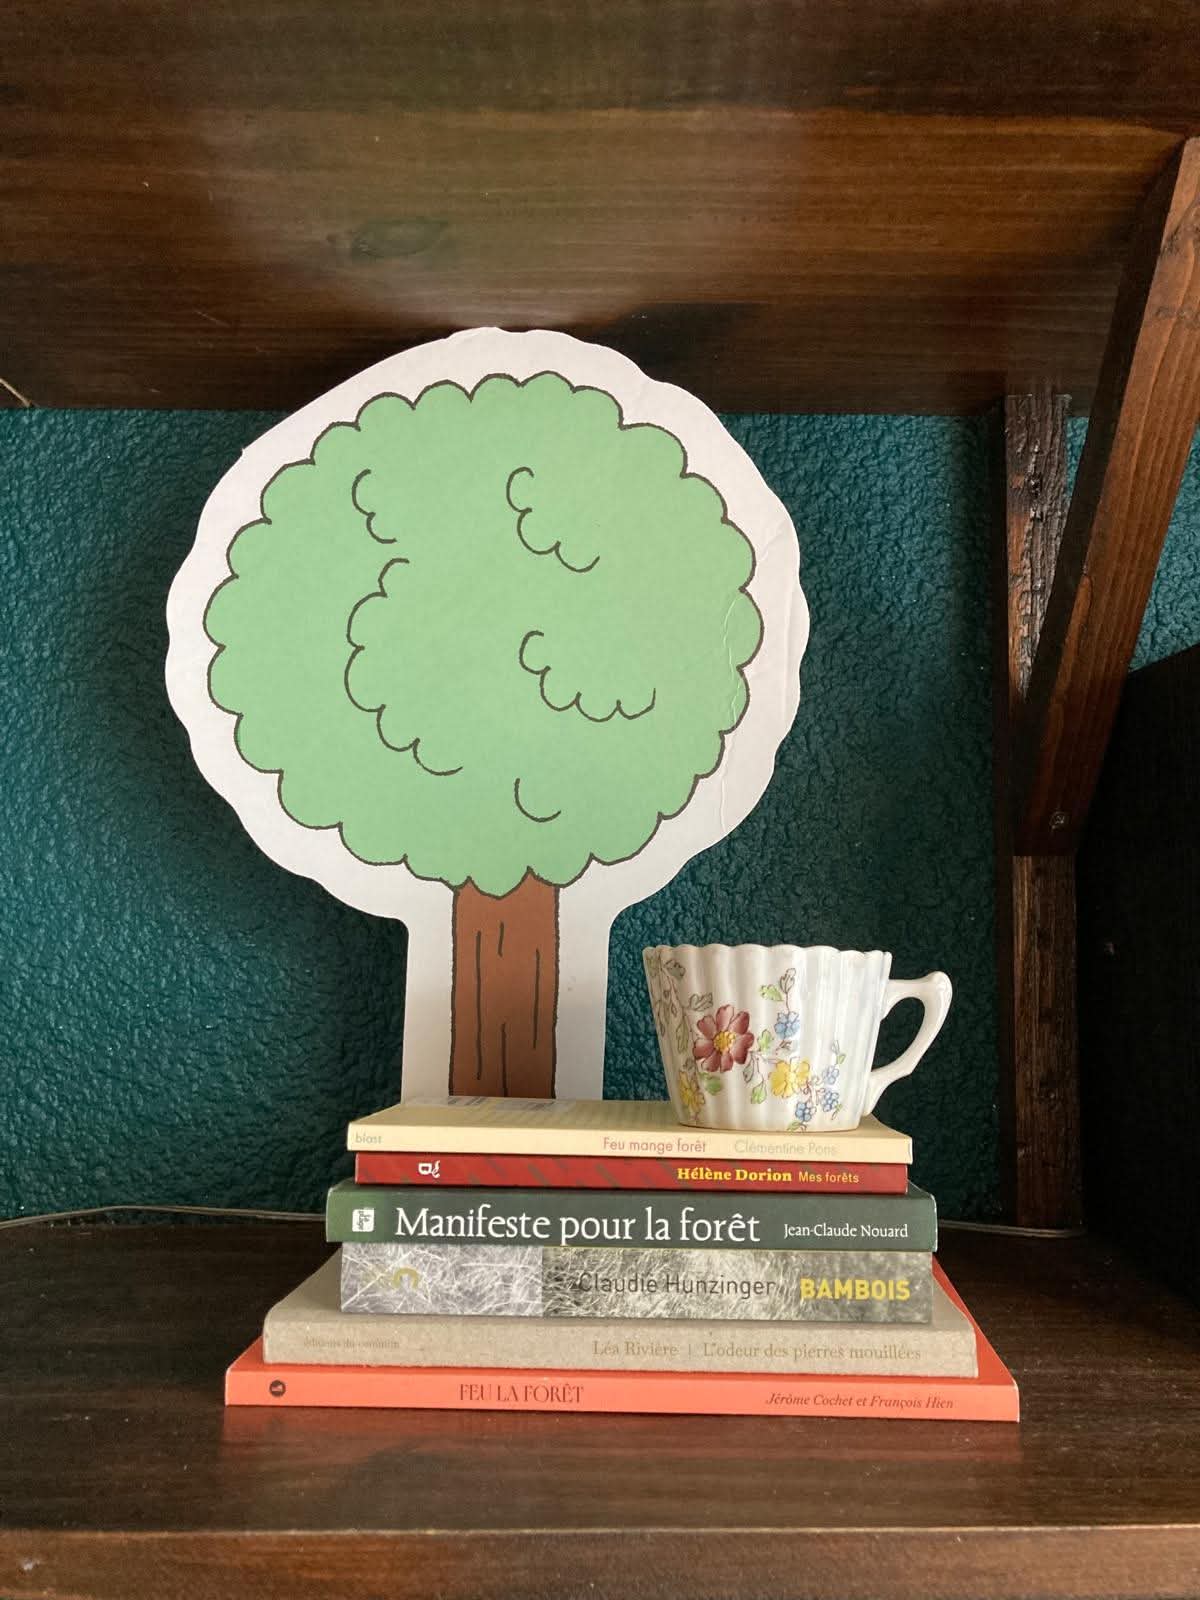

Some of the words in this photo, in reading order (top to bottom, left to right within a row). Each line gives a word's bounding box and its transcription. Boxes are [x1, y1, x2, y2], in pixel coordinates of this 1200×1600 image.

[603, 1137, 625, 1151] Feu
[629, 1140, 672, 1154] mange
[677, 1138, 707, 1152] forêt
[677, 1166, 732, 1182] Hélène
[735, 1168, 792, 1182] Dorion
[798, 1171, 824, 1183] Mes
[825, 1170, 860, 1184] forêts
[395, 1203, 551, 1240] Manifeste
[559, 1216, 636, 1247] pour
[644, 1206, 671, 1241] la
[679, 1206, 761, 1242] forêt
[783, 1222, 858, 1239] Jean-Claude
[860, 1223, 909, 1239] Nouard
[577, 1270, 659, 1295] Claudie
[665, 1274, 777, 1303] Hunzinger
[800, 1277, 911, 1301] BAMBOIS
[592, 1340, 619, 1356] Léa
[624, 1340, 681, 1356] Rivière
[764, 1343, 789, 1358] des
[793, 1343, 845, 1363] pierres
[850, 1343, 922, 1360] mouillées
[459, 1383, 492, 1401] FEU
[497, 1384, 519, 1402] LA
[523, 1382, 585, 1404] FORÊT
[765, 1391, 811, 1406] Jérôme
[813, 1393, 852, 1407] Cochet
[856, 1395, 868, 1407] et
[870, 1395, 922, 1410] François
[925, 1396, 954, 1409] Hien
